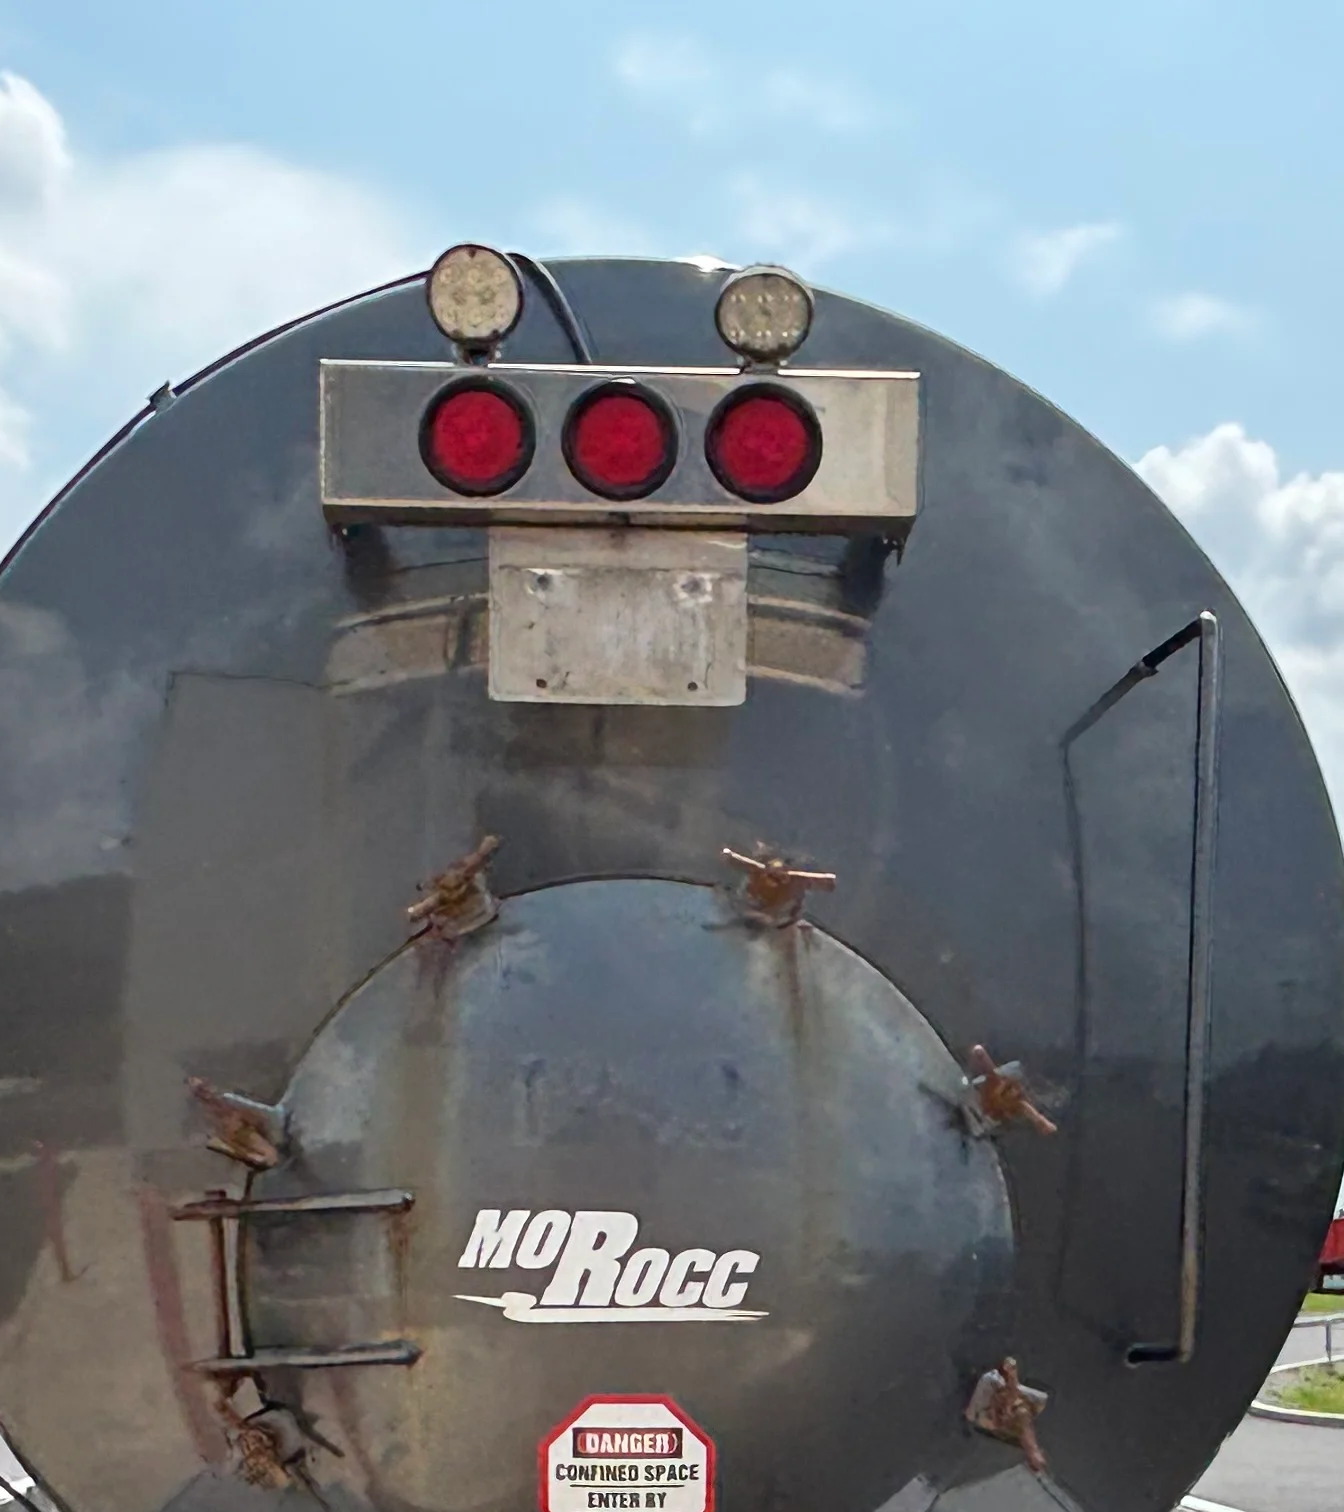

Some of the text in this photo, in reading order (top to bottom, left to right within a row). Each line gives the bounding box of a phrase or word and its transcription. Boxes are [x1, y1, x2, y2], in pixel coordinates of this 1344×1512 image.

[585, 1432, 670, 1454] DANGER
[555, 1463, 700, 1482] CONFINED SPACE
[587, 1491, 667, 1509] ENTER BY
